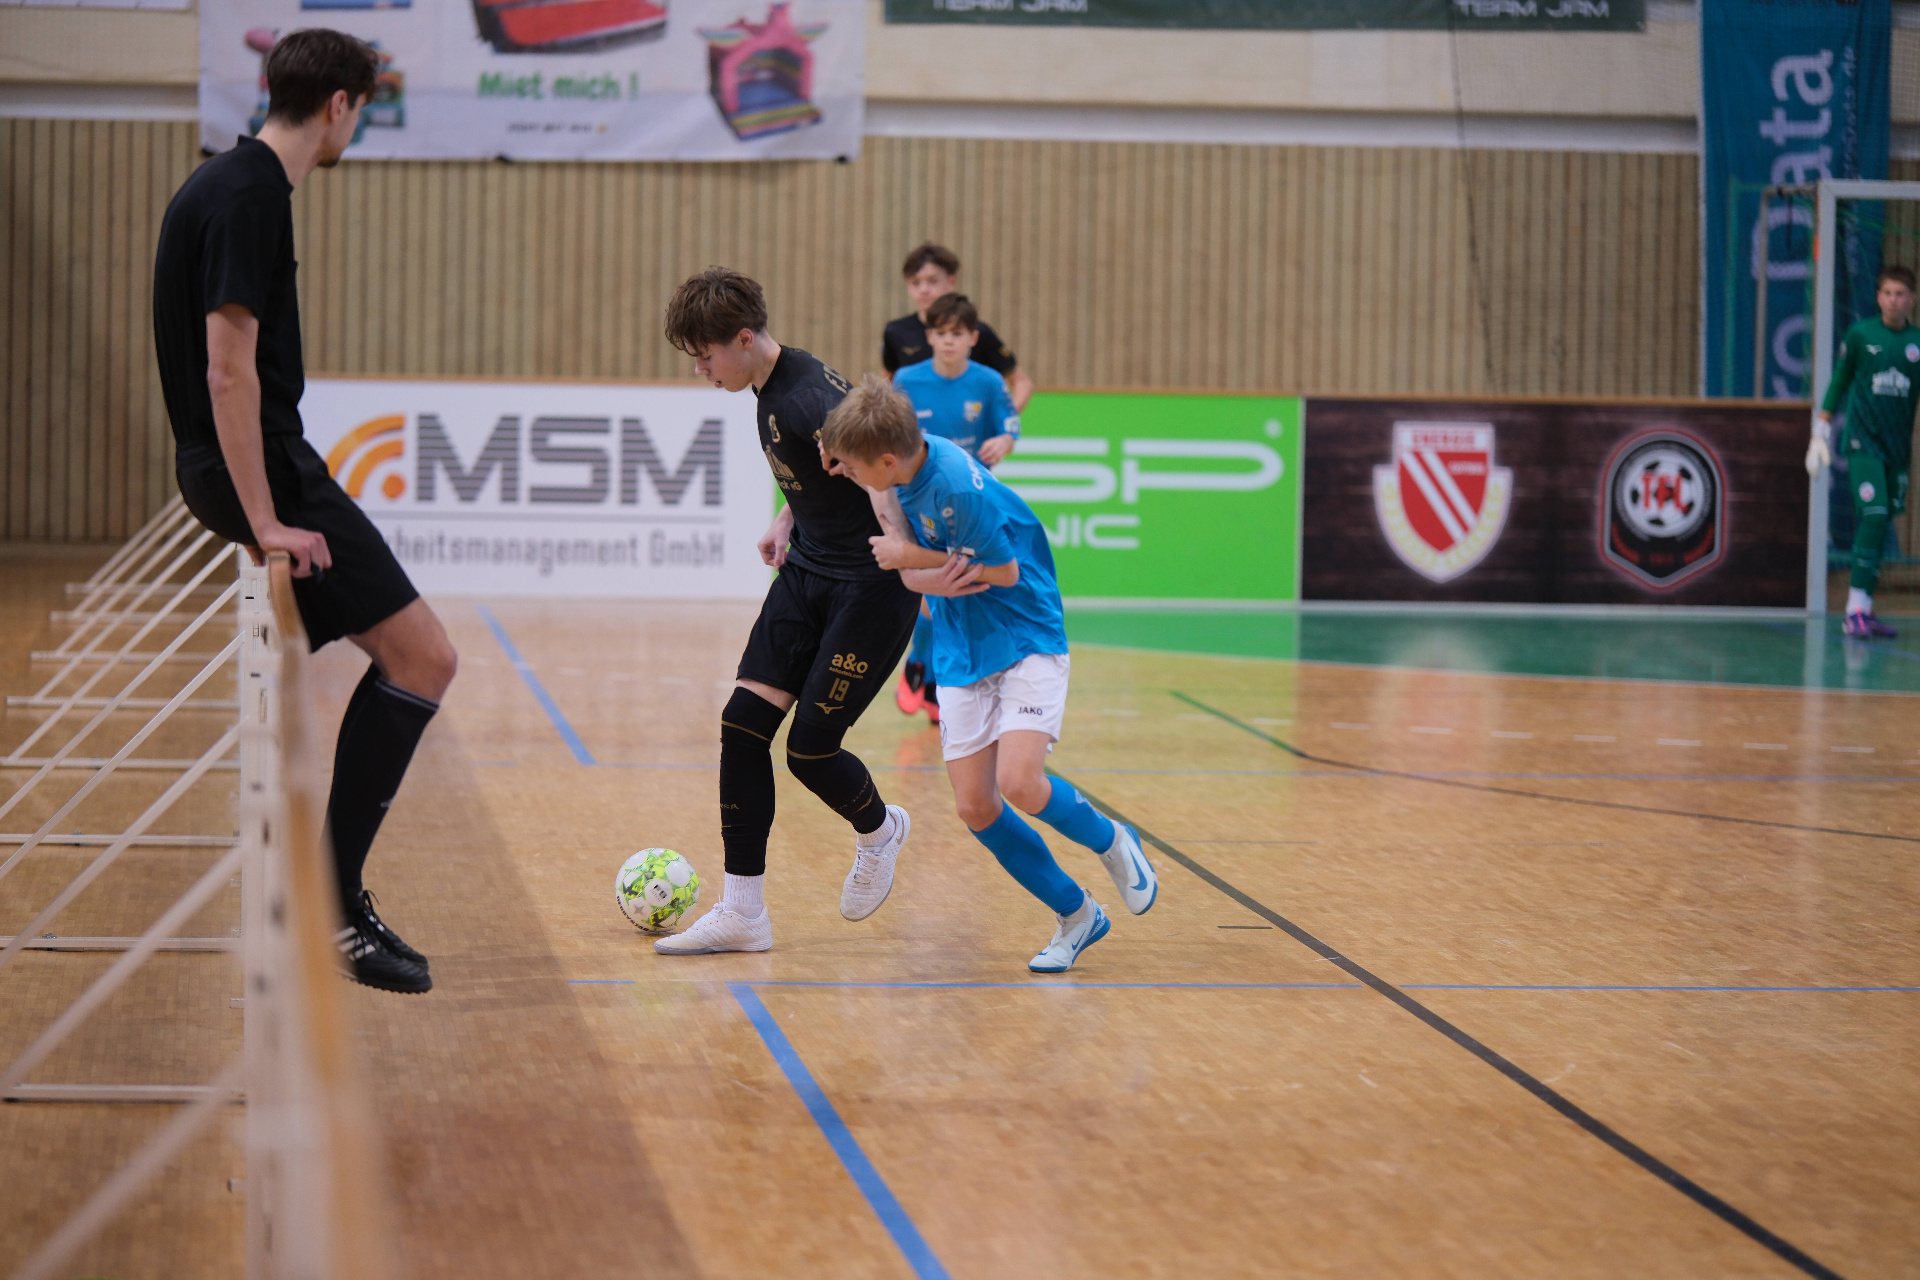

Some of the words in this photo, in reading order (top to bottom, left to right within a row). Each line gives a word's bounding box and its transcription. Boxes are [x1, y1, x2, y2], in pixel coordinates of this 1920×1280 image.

[478, 71, 543, 100] Miet
[553, 71, 621, 100] mich
[416, 413, 724, 506] MSM
[990, 436, 1285, 504] SP
[383, 527, 640, 577] heitsmanagement
[649, 529, 725, 567] GmbH
[831, 652, 869, 674] a&o
[828, 677, 850, 701] 19
[1017, 706, 1043, 716] JAKO
